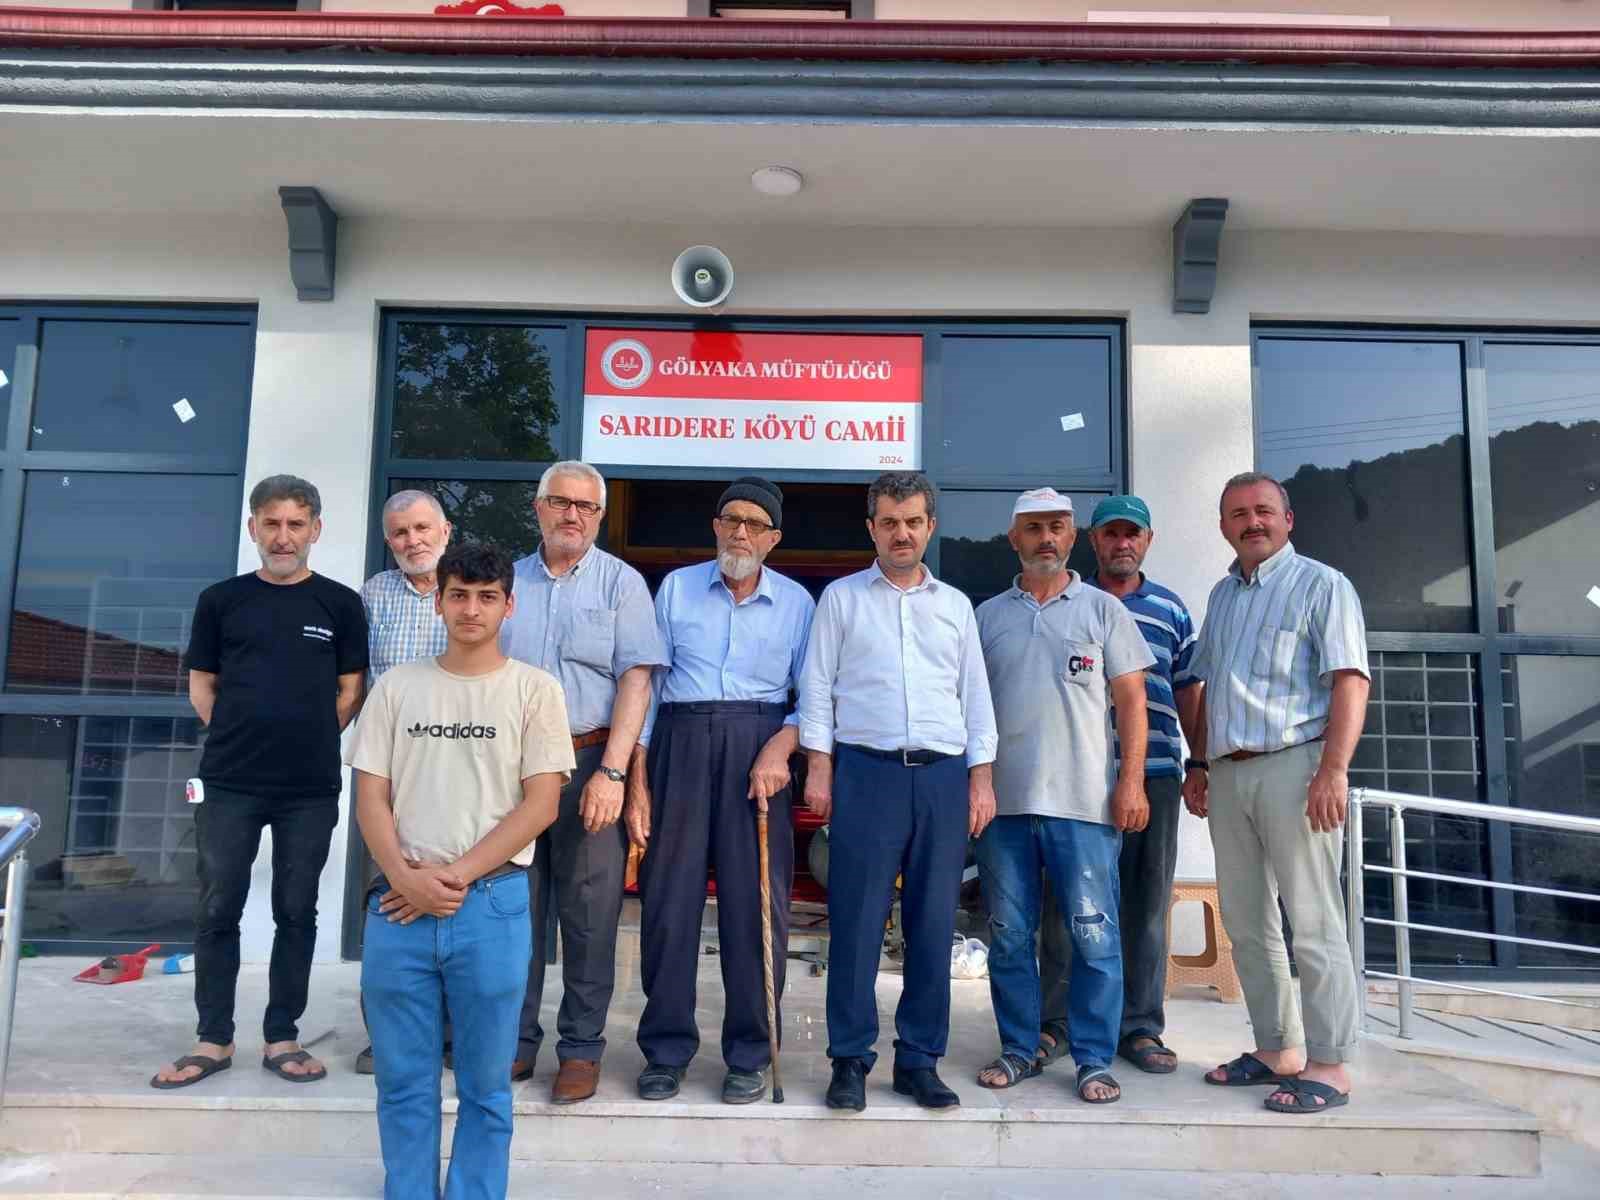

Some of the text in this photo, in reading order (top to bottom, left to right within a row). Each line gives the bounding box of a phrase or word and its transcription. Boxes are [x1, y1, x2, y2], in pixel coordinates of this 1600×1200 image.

[659, 357, 892, 381] GÖLYAKA MÜFTÜLÜĞÜ
[600, 414, 905, 442] SARIDERE KÖYÜ CAMİİ
[879, 456, 904, 465] 2024
[429, 722, 497, 739] adidas
